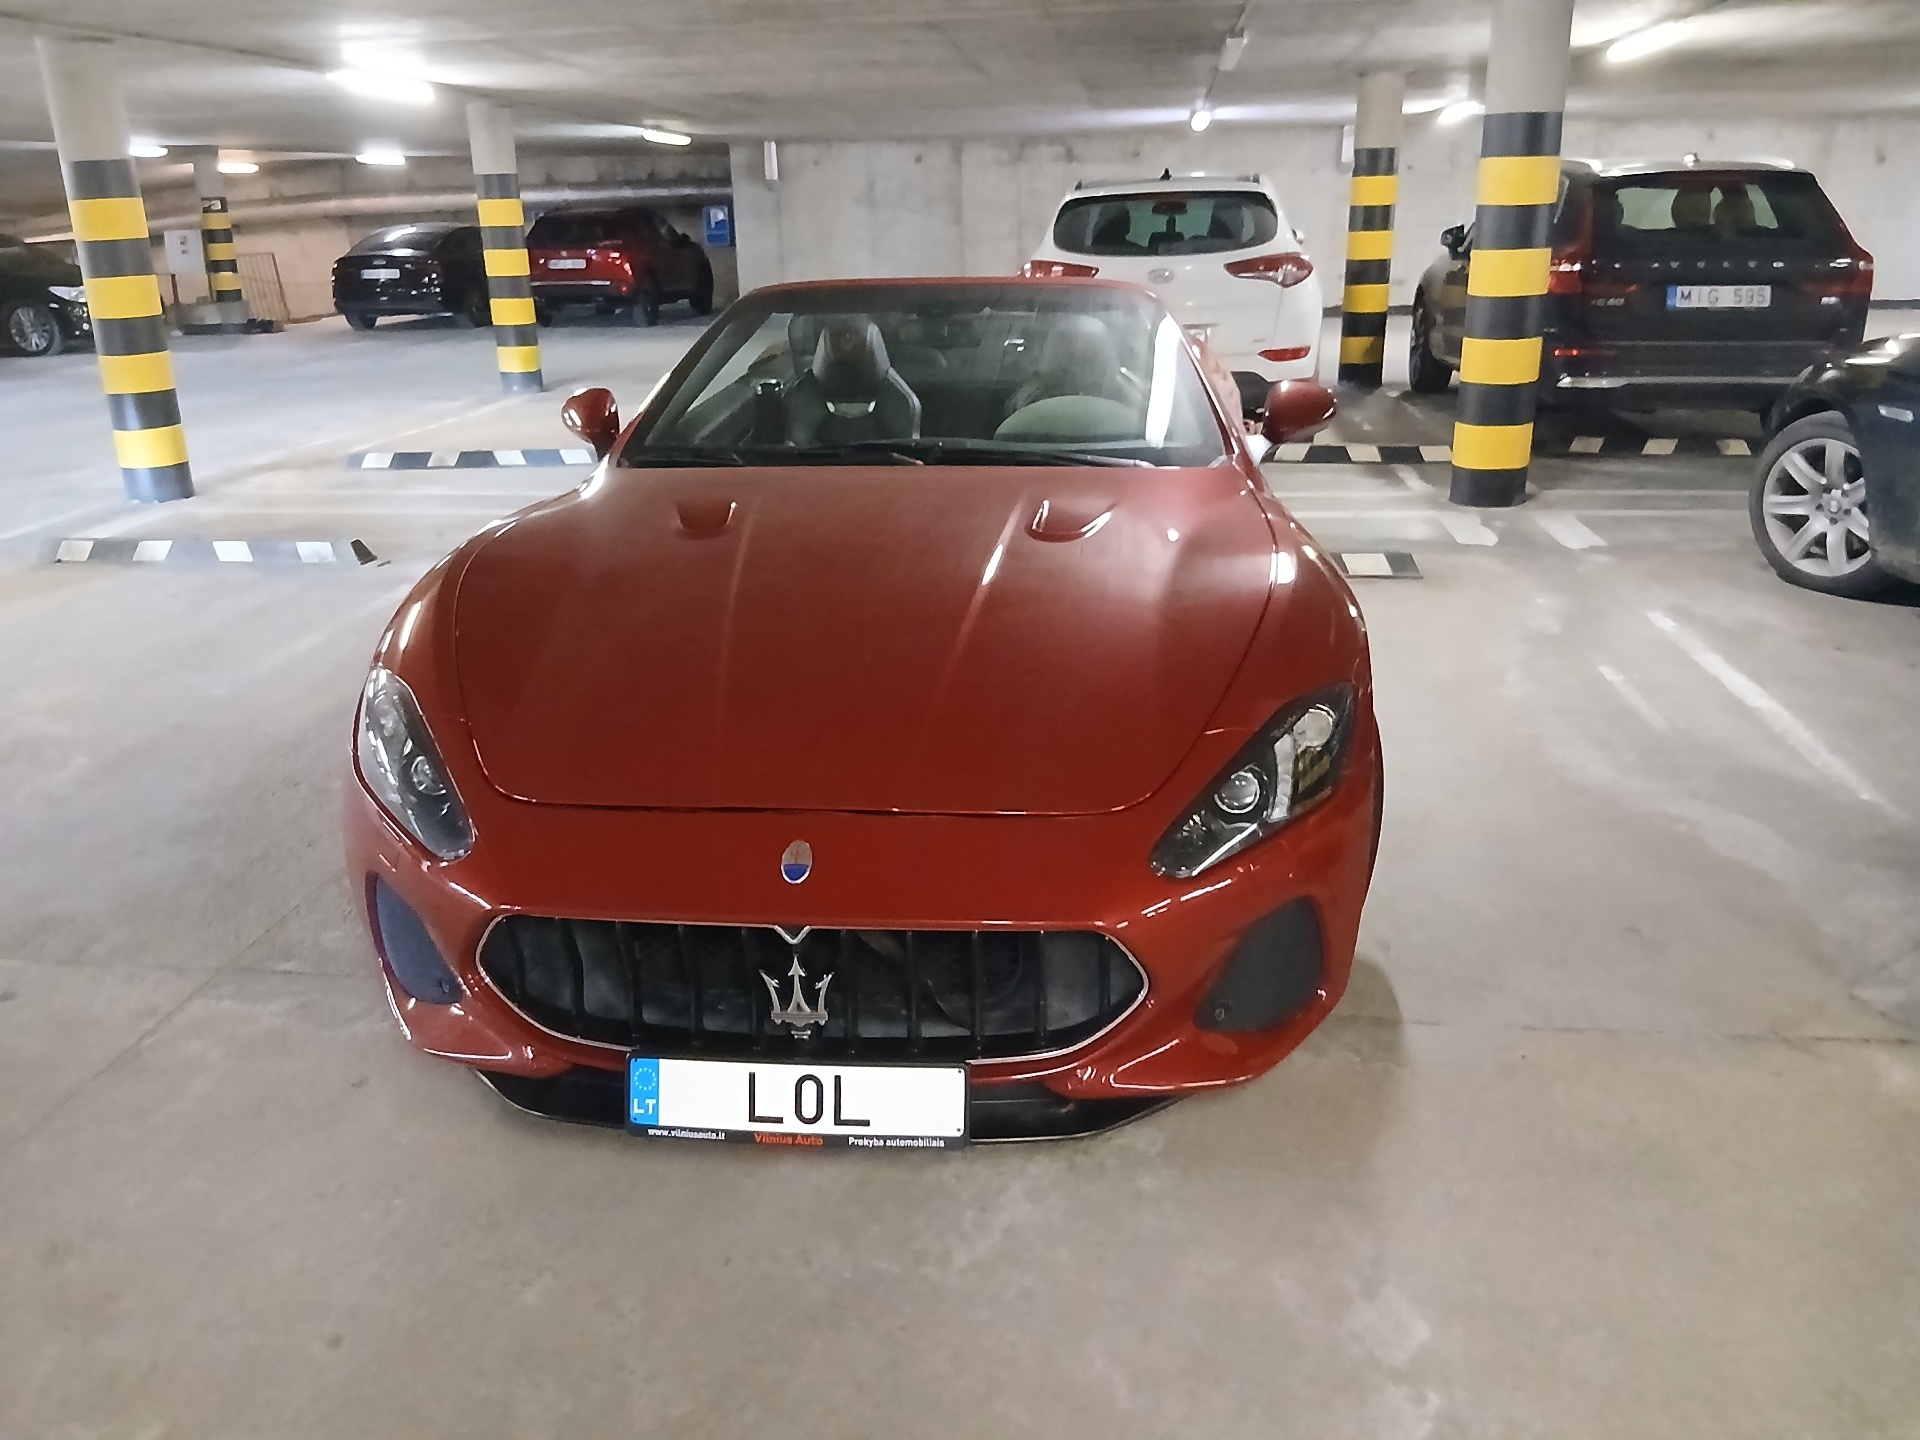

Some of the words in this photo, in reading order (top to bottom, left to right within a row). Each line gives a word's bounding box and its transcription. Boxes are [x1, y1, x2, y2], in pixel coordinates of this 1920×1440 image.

[633, 1098, 657, 1115] LT
[647, 1128, 726, 1140] www.vilniusauto.lt
[754, 1132, 793, 1145] Vilnius
[795, 1134, 824, 1146] Auto
[848, 1136, 884, 1148] Prekyba
